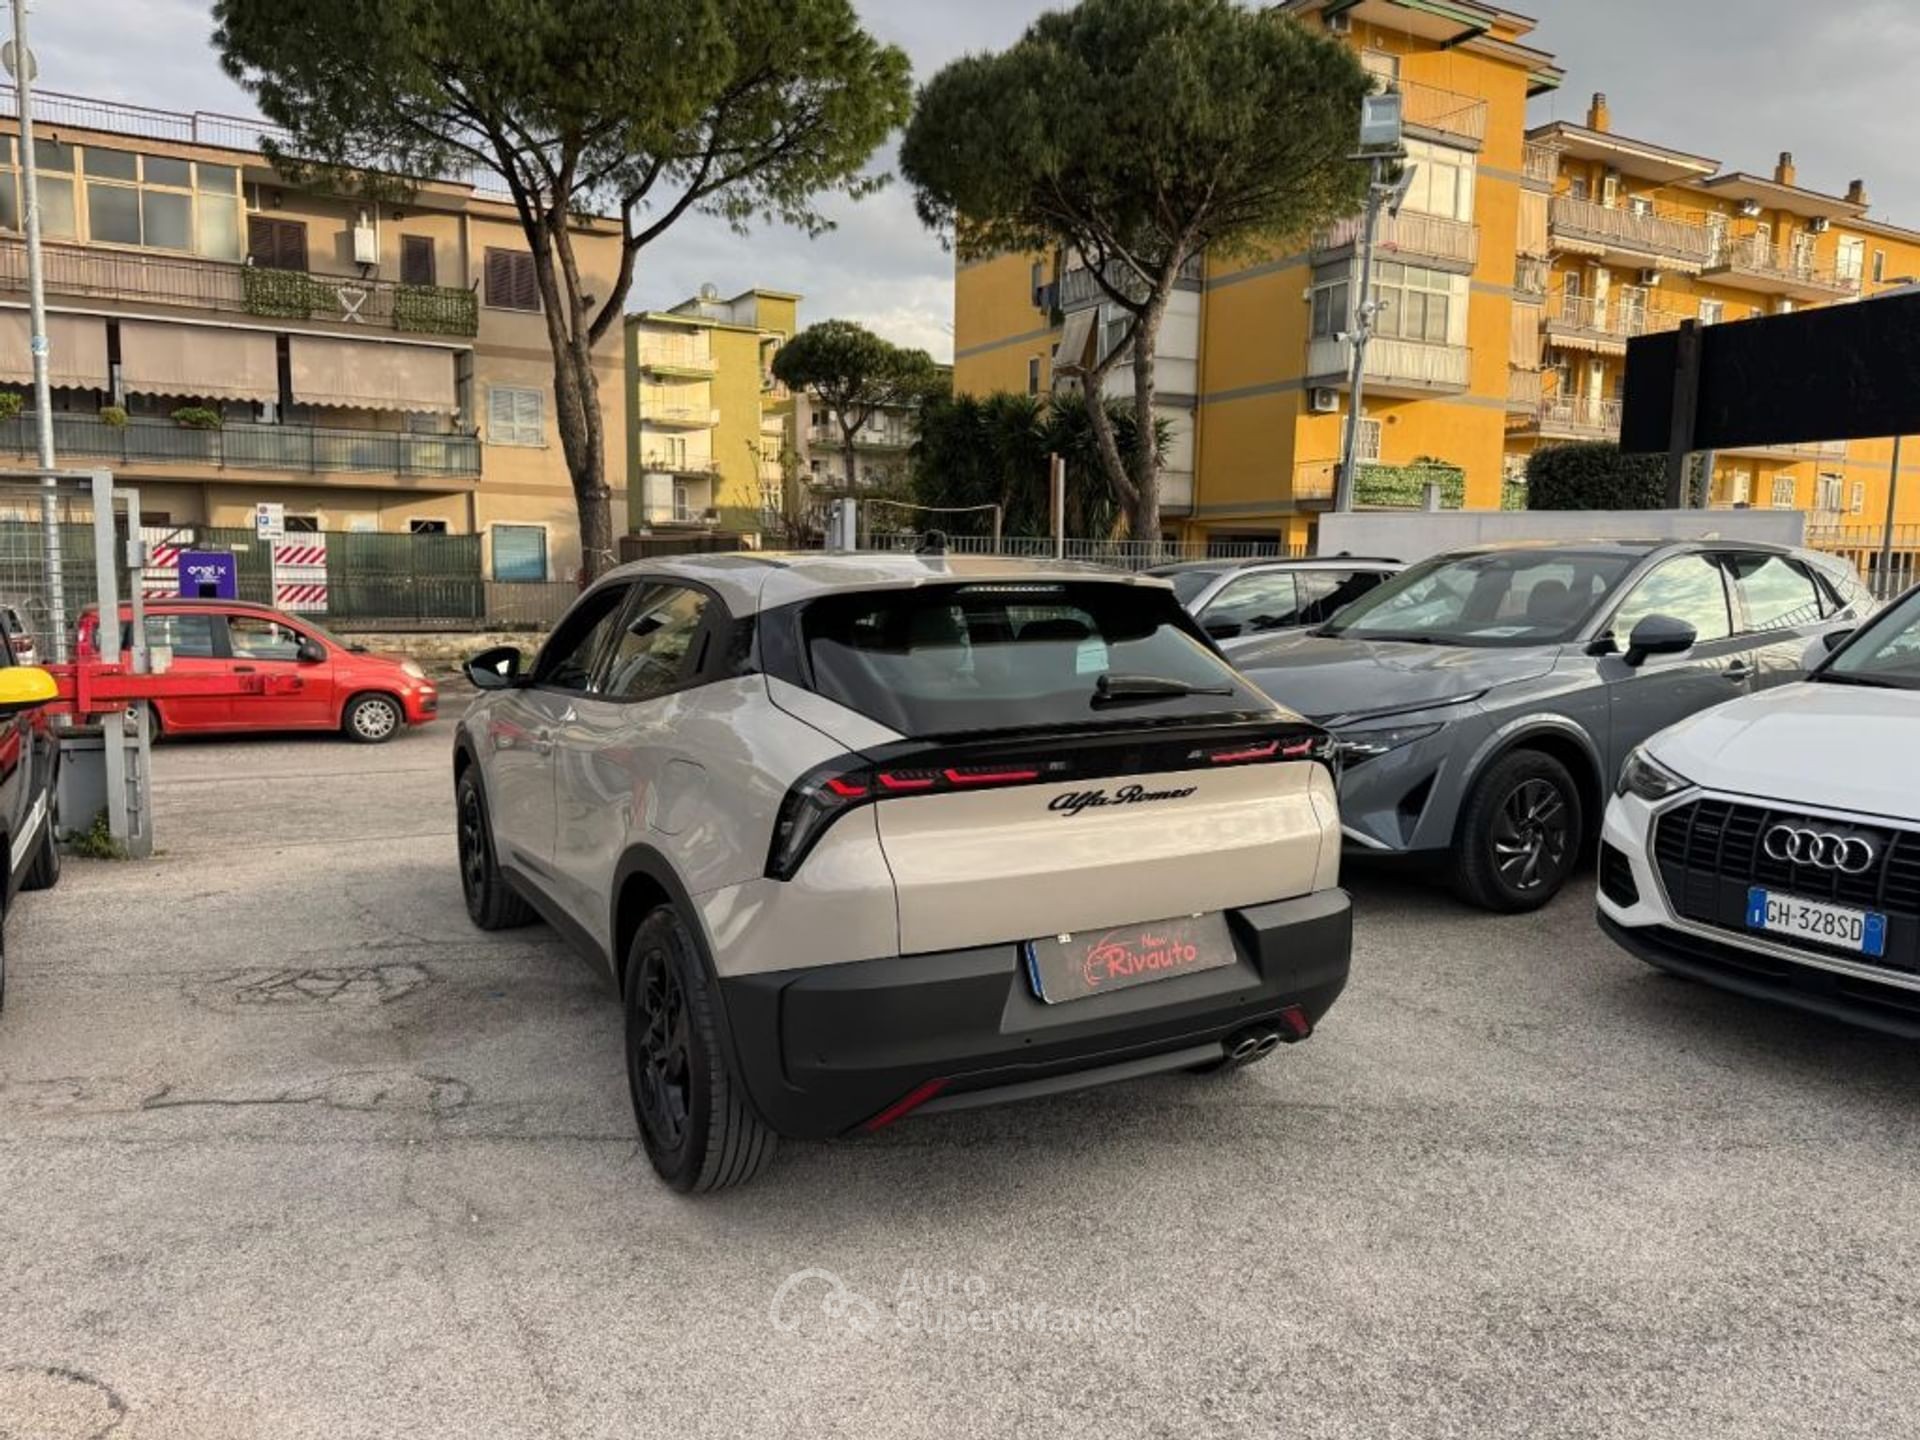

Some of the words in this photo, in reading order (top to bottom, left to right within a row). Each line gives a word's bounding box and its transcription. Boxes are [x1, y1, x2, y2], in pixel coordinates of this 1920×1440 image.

[1047, 789, 1109, 817] Alfa
[1112, 784, 1198, 804] Romeo
[1105, 942, 1196, 977] Rivauto
